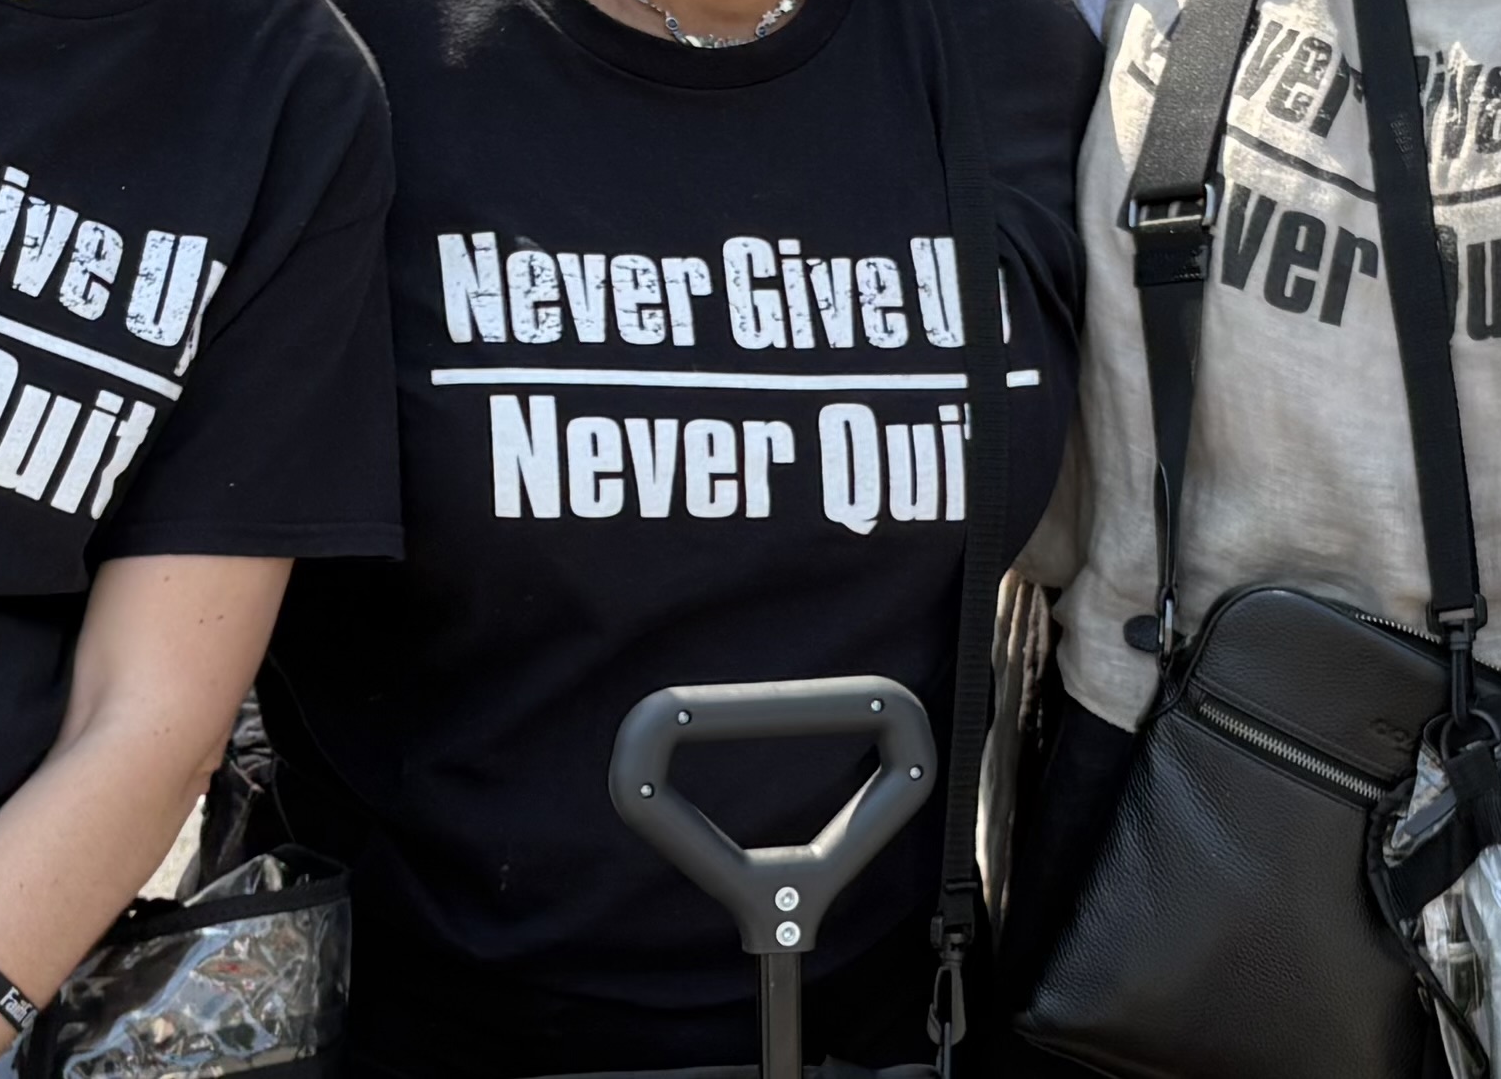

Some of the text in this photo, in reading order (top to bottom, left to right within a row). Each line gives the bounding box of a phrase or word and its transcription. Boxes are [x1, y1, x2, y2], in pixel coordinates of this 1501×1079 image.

[438, 232, 712, 347] Never
[722, 236, 909, 349] Give
[1220, 182, 1379, 327] ver
[490, 395, 971, 535] Never Qui
